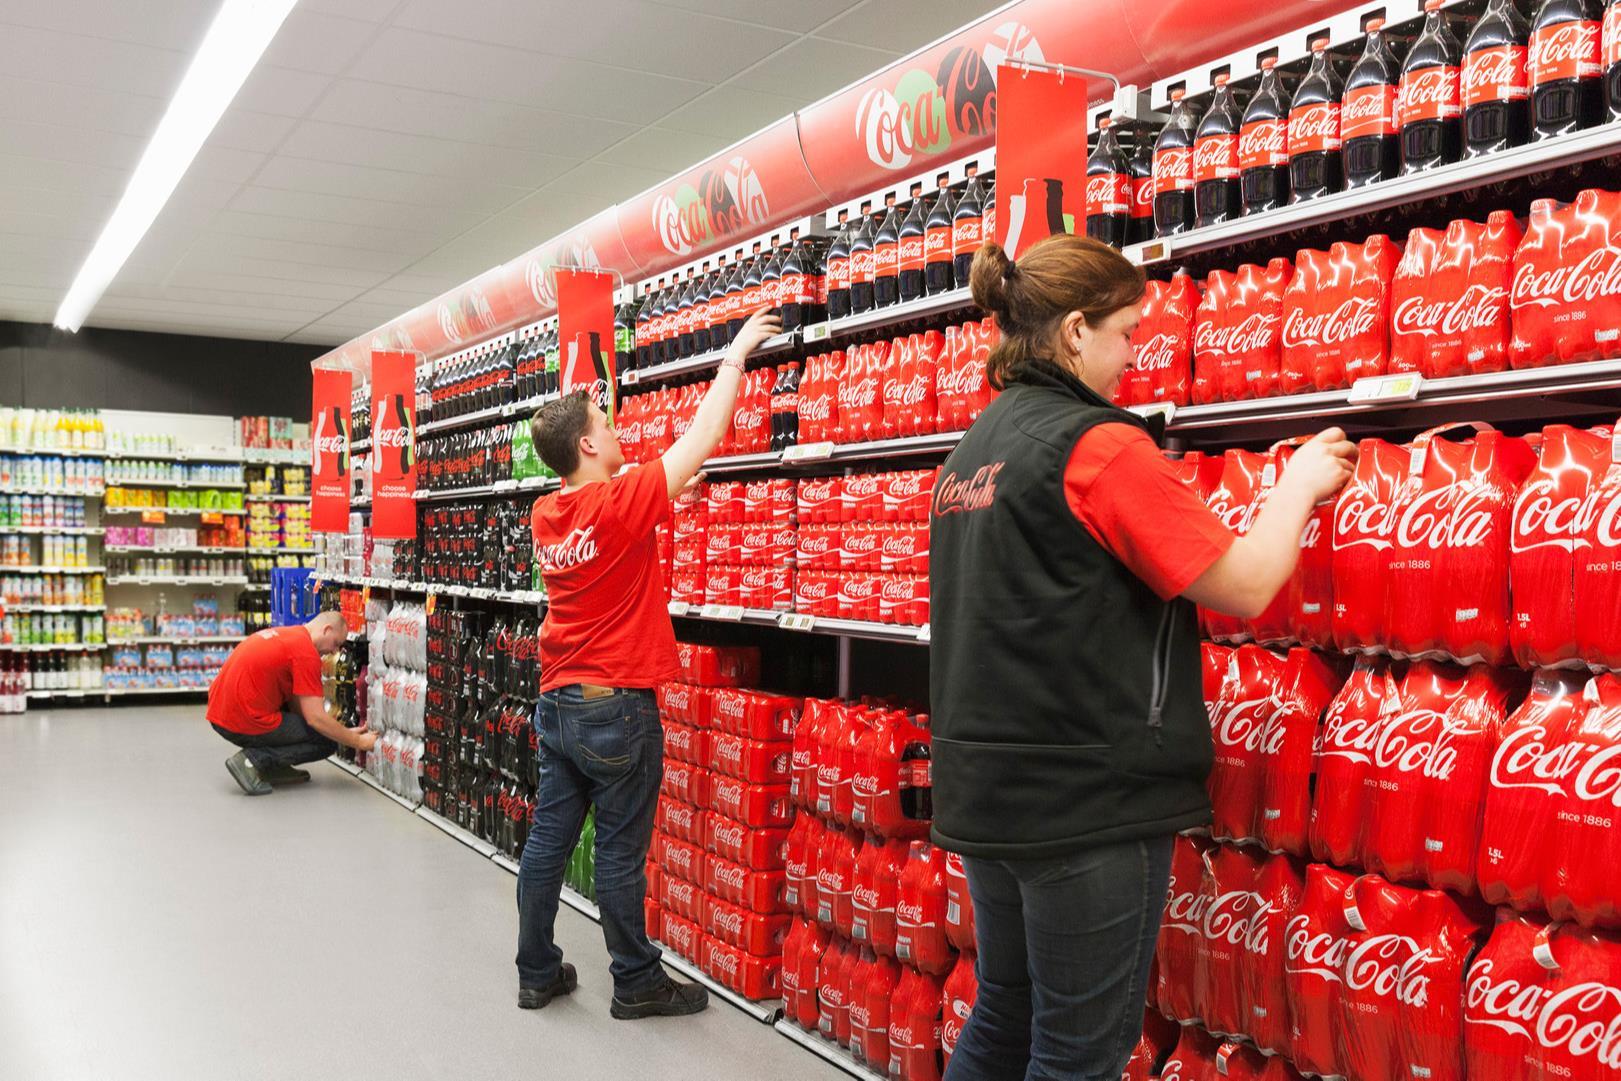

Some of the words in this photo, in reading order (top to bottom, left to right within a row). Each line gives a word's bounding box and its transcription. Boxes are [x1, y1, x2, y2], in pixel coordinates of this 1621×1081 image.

[652, 157, 770, 256] Coca-Cola
[1282, 297, 1382, 348] Coca-Cola
[1393, 285, 1509, 336] Coca-Cola
[1572, 312, 1587, 321] 1886
[1194, 313, 1281, 357] Coca-Cola
[883, 374, 931, 406] Coca-Cola
[934, 461, 1006, 517] Coca-Cola
[1407, 559, 1431, 570] 1886
[1226, 756, 1246, 768] 1886
[1379, 779, 1399, 792] 1886
[1582, 812, 1613, 829] 1886
[1161, 875, 1283, 957] oca-Cola
[1211, 949, 1231, 961] 1886
[1285, 914, 1446, 1009] Coca-Cola
[1355, 1001, 1379, 1015] 1886
[1545, 1060, 1572, 1079] 1886
